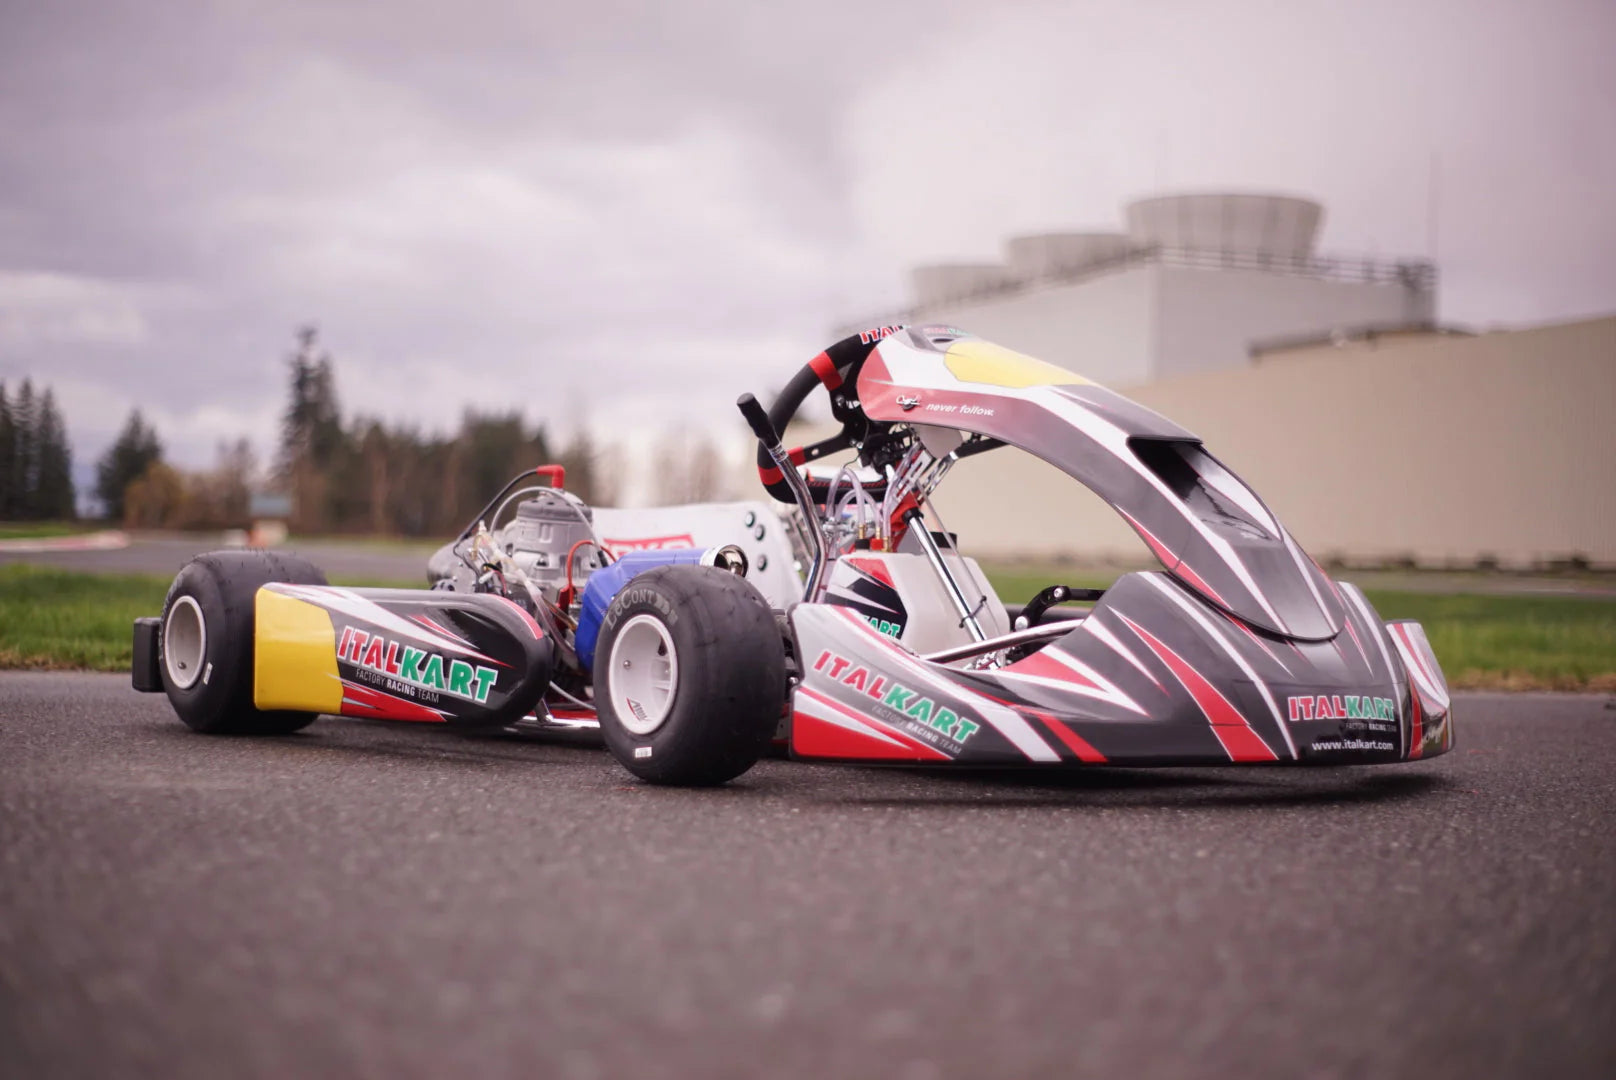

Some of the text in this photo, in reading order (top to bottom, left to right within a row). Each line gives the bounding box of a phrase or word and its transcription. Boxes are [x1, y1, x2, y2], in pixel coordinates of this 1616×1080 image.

[925, 403, 957, 413] never
[337, 625, 498, 704] ITALKART
[356, 668, 440, 704] FACTORY RACING TEAM
[813, 648, 980, 744] ITALKART
[1288, 695, 1395, 721] ITALKART
[906, 721, 939, 743] RACING
[939, 739, 962, 754] TEAM
[1369, 722, 1386, 732] RACING
[1312, 739, 1394, 751] www.italkart.com
